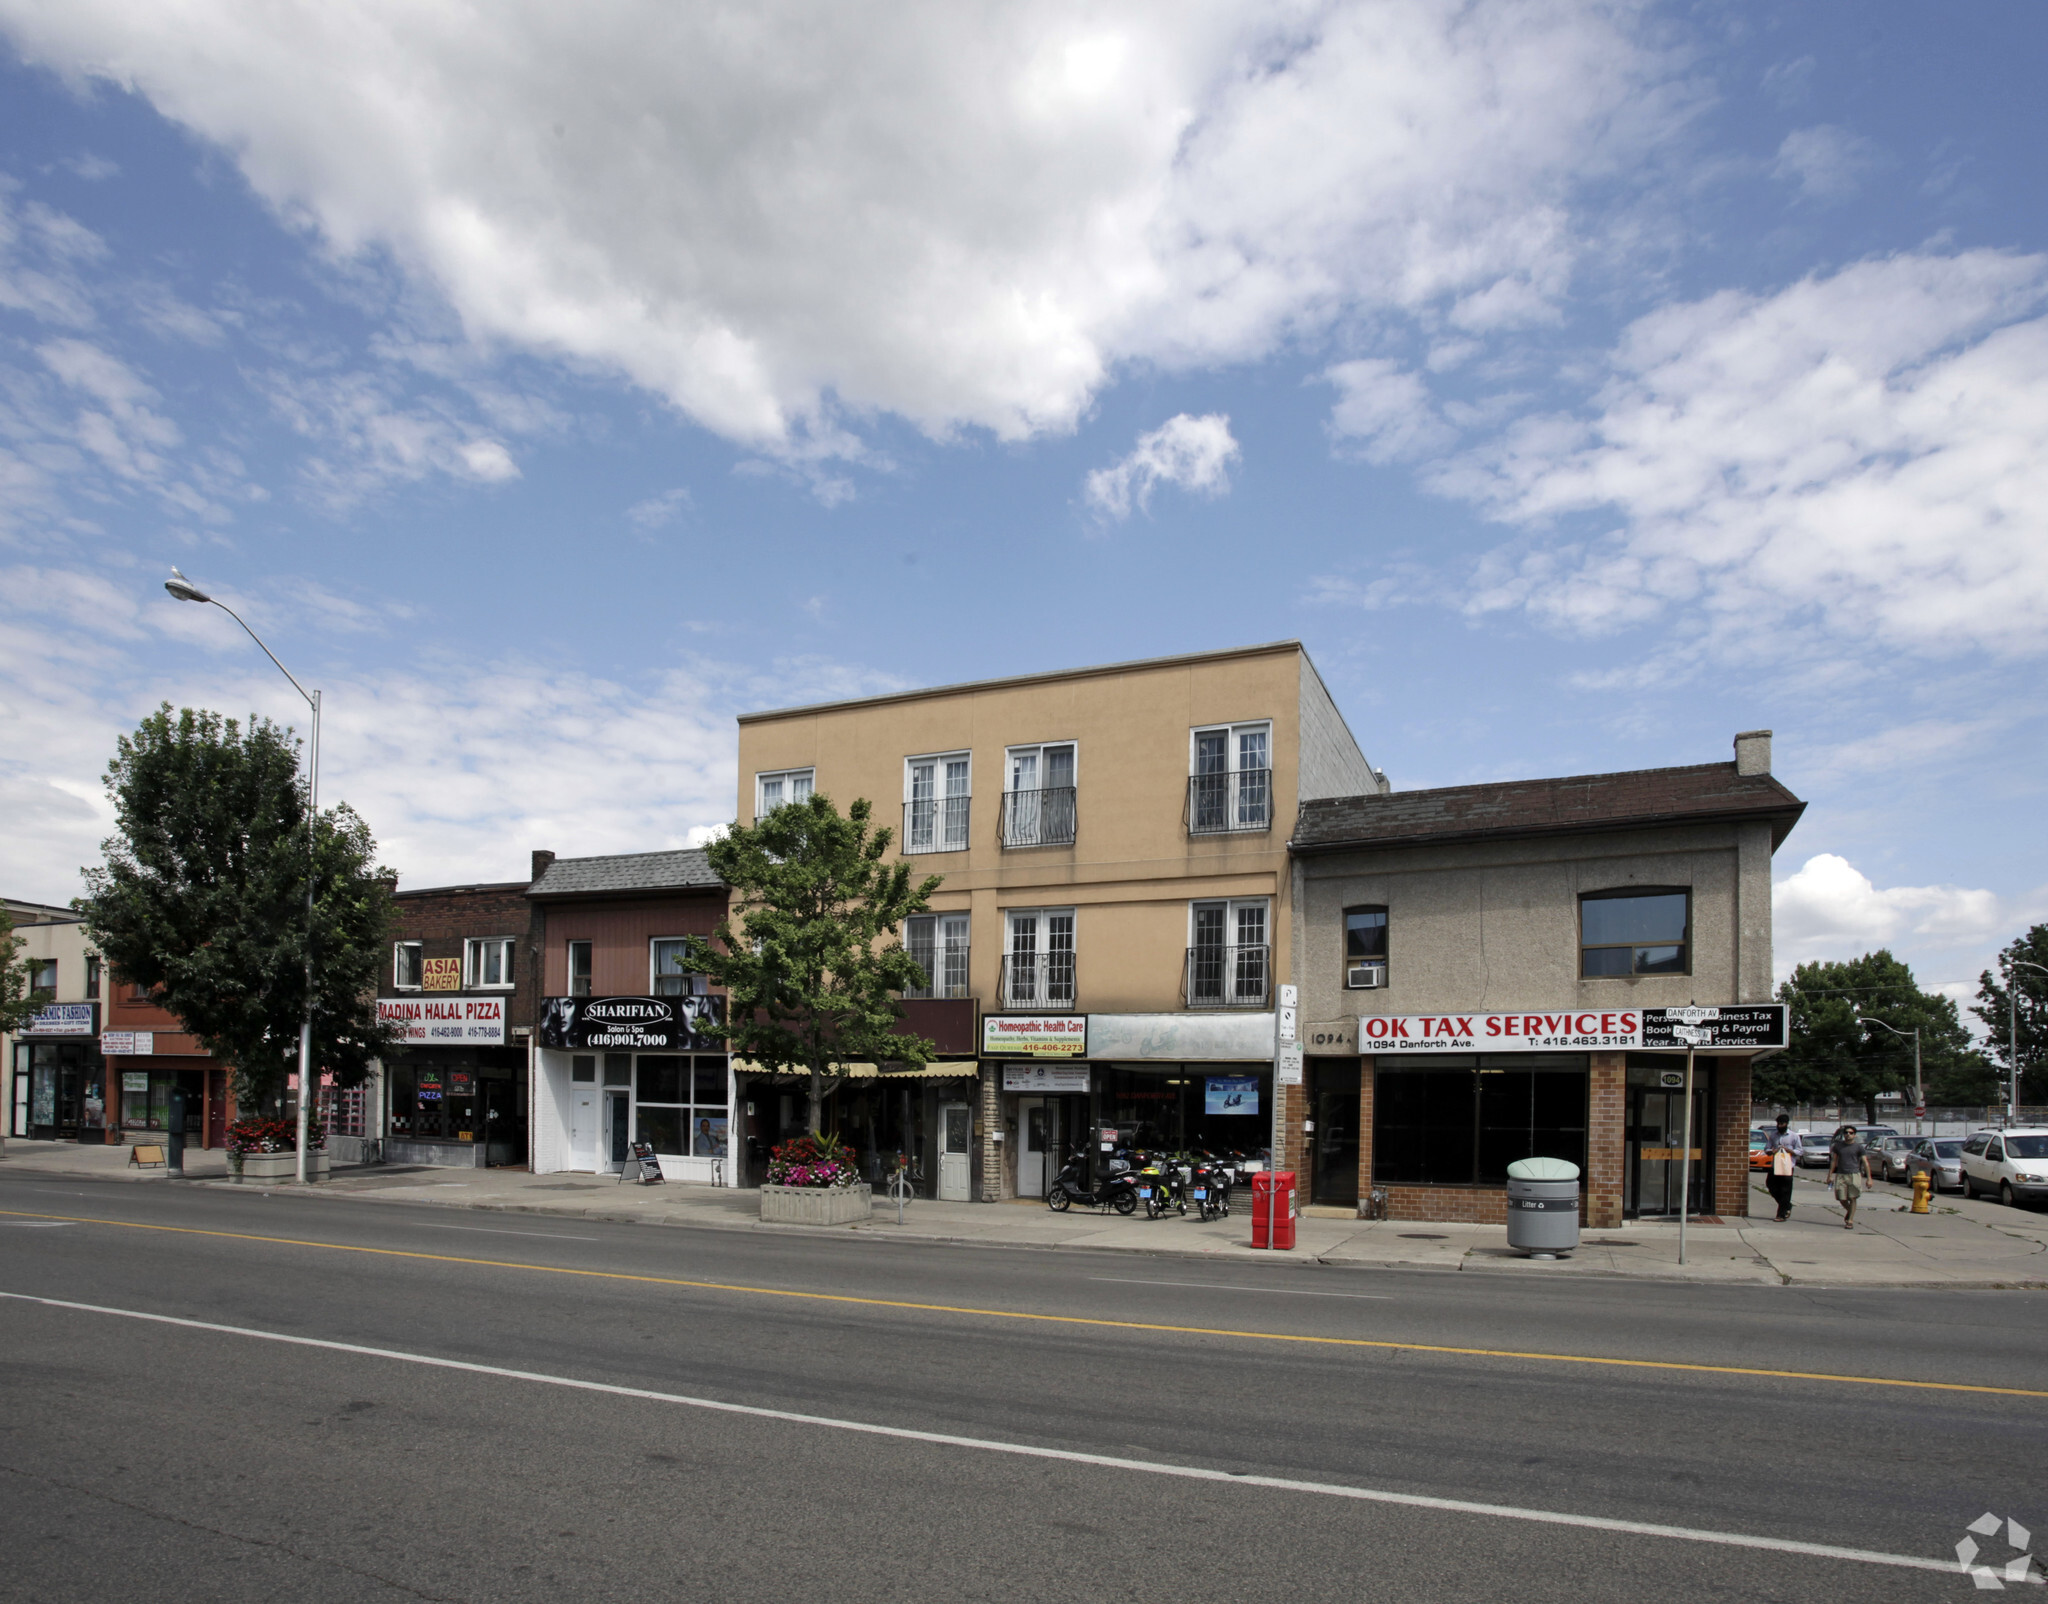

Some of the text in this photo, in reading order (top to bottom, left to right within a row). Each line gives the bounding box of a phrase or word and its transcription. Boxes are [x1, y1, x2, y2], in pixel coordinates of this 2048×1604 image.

[424, 960, 459, 974] ASIA
[424, 975, 459, 989] BAKERY
[62, 1006, 91, 1019] FASHION
[379, 1002, 501, 1020] MADINA HALAL PIZZA
[589, 1005, 665, 1017] SHARIFIAN
[1668, 1008, 1717, 1017] DANFORTH AV
[1753, 1011, 1772, 1020] Tax
[607, 1025, 625, 1033] Salon
[632, 1026, 644, 1035] Spa
[998, 1020, 1083, 1035] Homeopathic Health Care
[1366, 1013, 1637, 1038] OK TAX SERVICES
[1721, 1024, 1730, 1032] &
[1733, 1023, 1770, 1035] Payroll
[408, 1027, 426, 1038] WINGS
[431, 1027, 463, 1038] 416-462-9000
[1675, 1027, 1701, 1038] CAITHNESS
[1702, 1030, 1710, 1039] AV
[587, 1033, 667, 1047] (416)901.7000
[1311, 1033, 1344, 1045] 1094
[1366, 1039, 1475, 1049] 1094 Danforth Ave.
[1528, 1036, 1635, 1046] T: 416.463.3181
[1646, 1038, 1667, 1046] Year
[1714, 1037, 1758, 1046] Services
[1023, 1044, 1083, 1052] 416-406-2273
[1664, 1076, 1680, 1084] 1094
[419, 1091, 442, 1100] PIZZA
